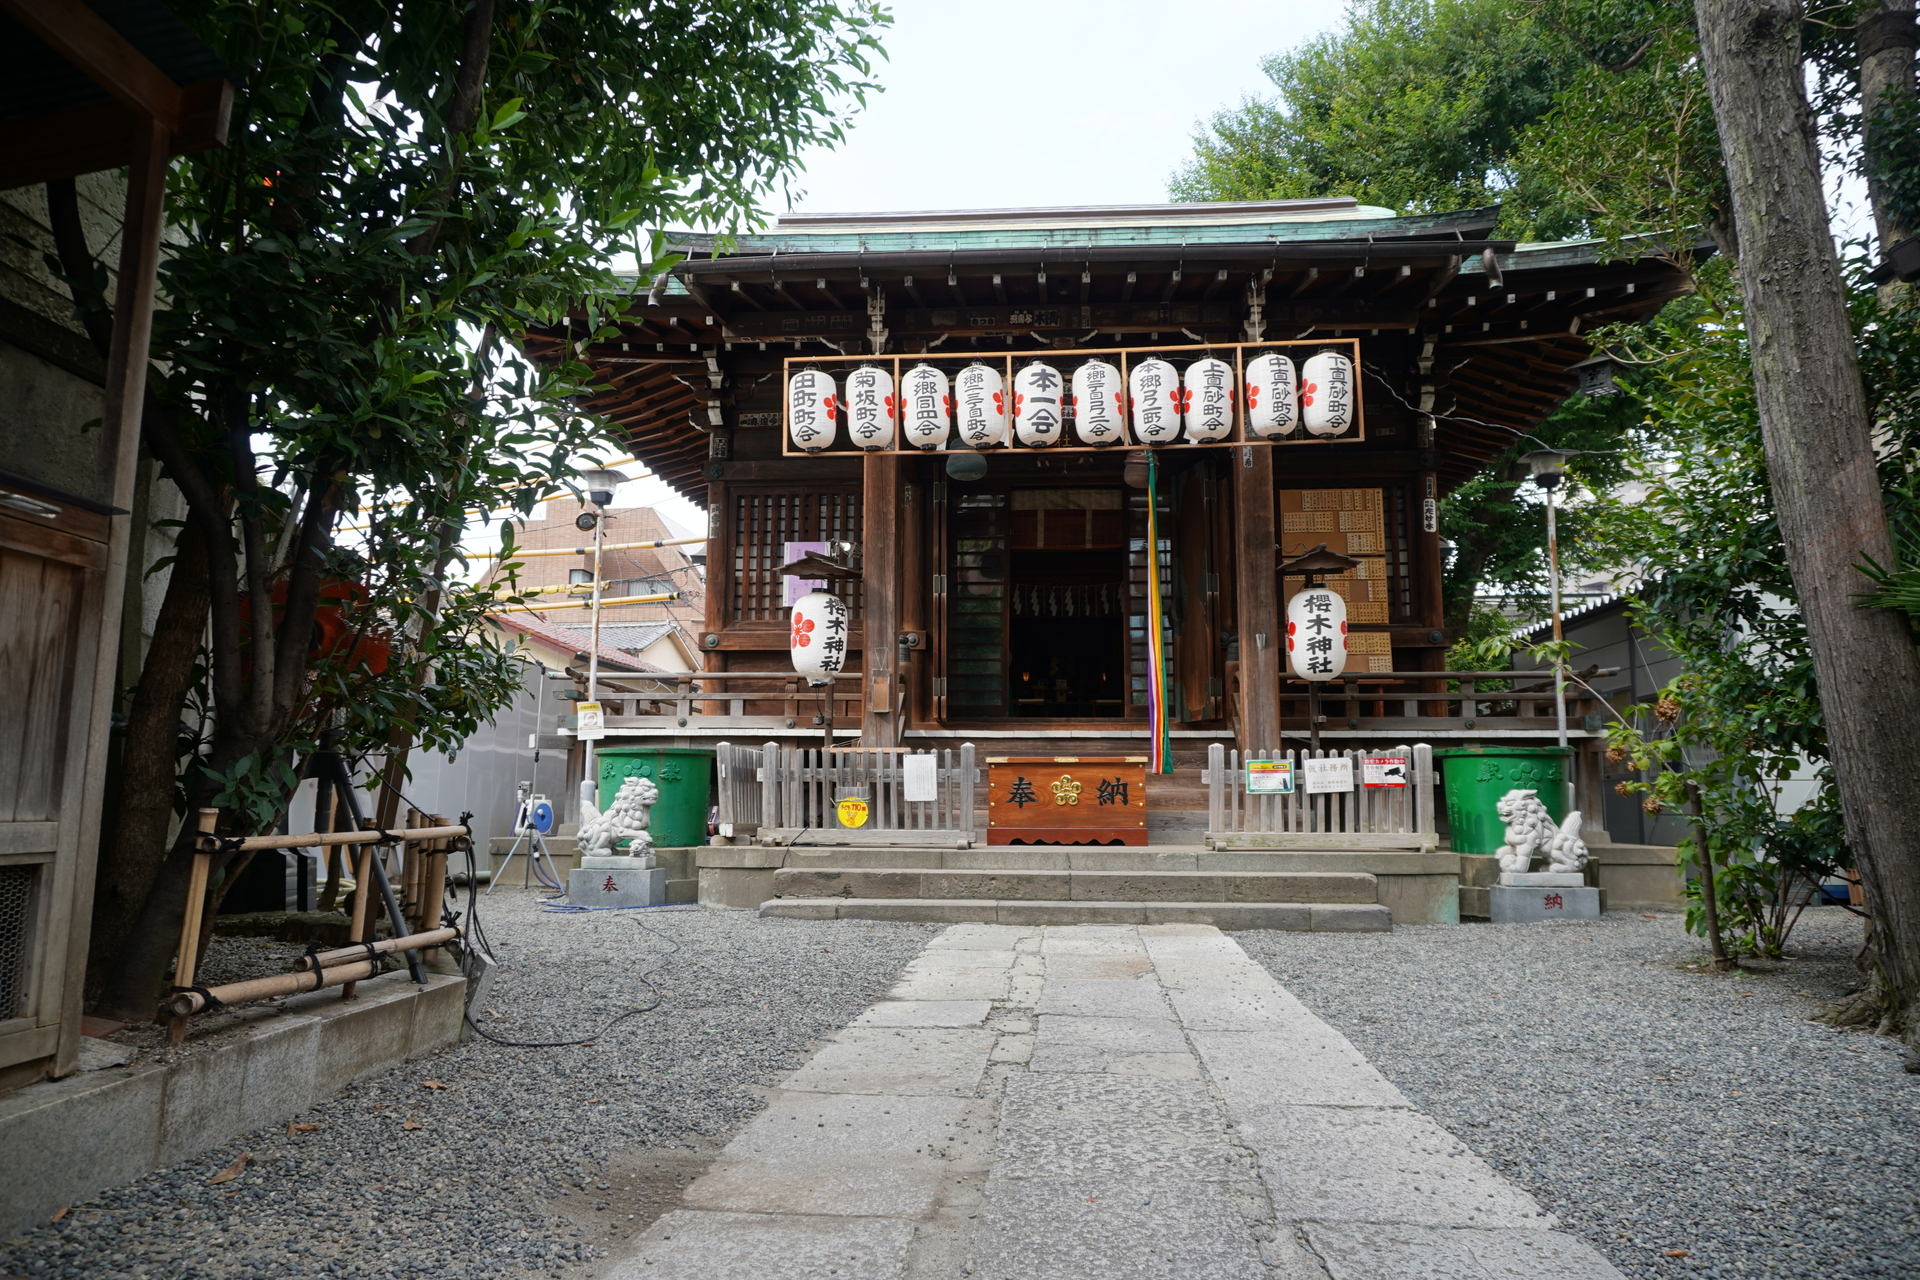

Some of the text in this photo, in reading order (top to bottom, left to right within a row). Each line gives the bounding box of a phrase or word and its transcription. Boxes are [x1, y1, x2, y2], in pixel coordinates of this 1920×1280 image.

[793, 373, 821, 442] 田町町会
[854, 371, 882, 439] 菊坂町会
[1026, 368, 1059, 434] 本一会
[1085, 363, 1111, 437] 本郷二丁目弓二会
[1138, 362, 1166, 436] 本郷弓一町会
[1202, 362, 1225, 431] 上真砂町会
[1269, 356, 1293, 427] 中真砂町会
[1326, 356, 1348, 428] 下真砂町会
[1303, 594, 1334, 675] 櫻木神社
[1006, 775, 1130, 809] 奉 納
[1307, 763, 1349, 773] 仮社務所
[602, 875, 619, 894] 奉
[1543, 893, 1563, 910] 納
